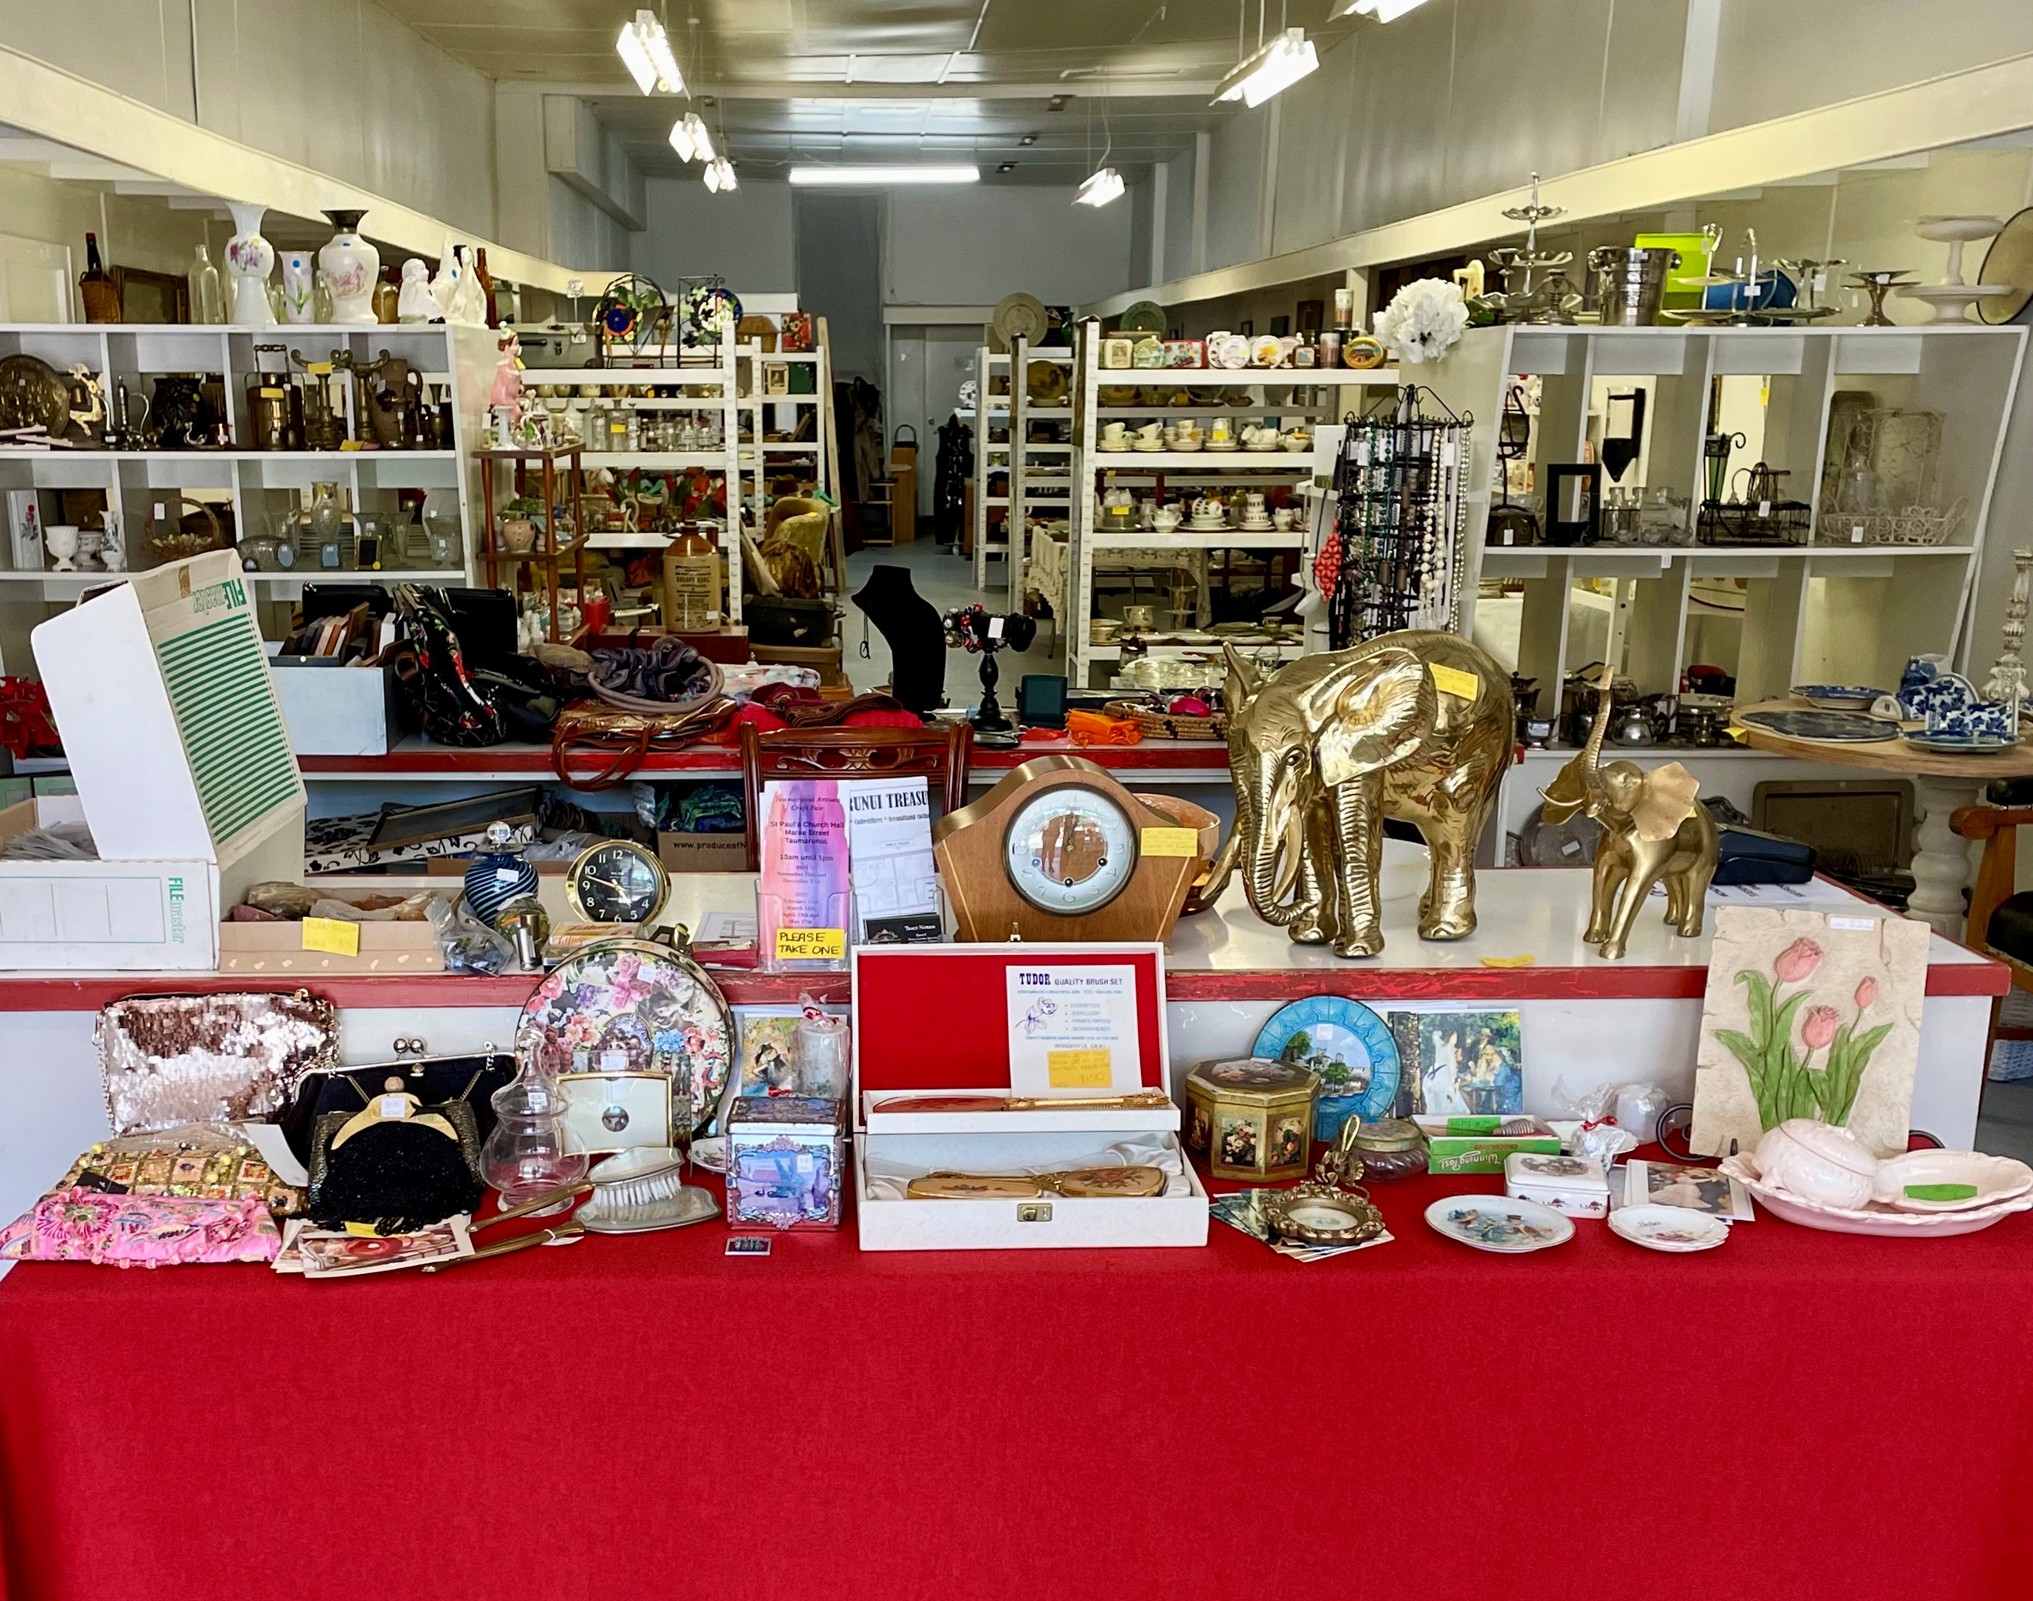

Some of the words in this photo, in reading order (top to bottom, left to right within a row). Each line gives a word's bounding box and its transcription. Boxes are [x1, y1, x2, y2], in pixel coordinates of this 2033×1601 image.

[598, 854, 607, 864] 11
[612, 850, 623, 860] 12
[584, 865, 596, 875] 10
[582, 881, 590, 891] 9
[586, 897, 595, 907] 8
[641, 899, 649, 909] 4
[168, 877, 186, 944] FILEmaster
[598, 909, 606, 919] 7
[630, 910, 638, 920] 5
[614, 914, 622, 922] 6
[779, 931, 827, 943] PLEASE
[778, 944, 808, 954] TAKE
[812, 945, 841, 955] ONE
[1019, 973, 1051, 986] TUDOR
[1054, 978, 1084, 986] QUALITY
[1086, 977, 1109, 986] BRUSH
[1459, 1150, 1502, 1165] Winning
